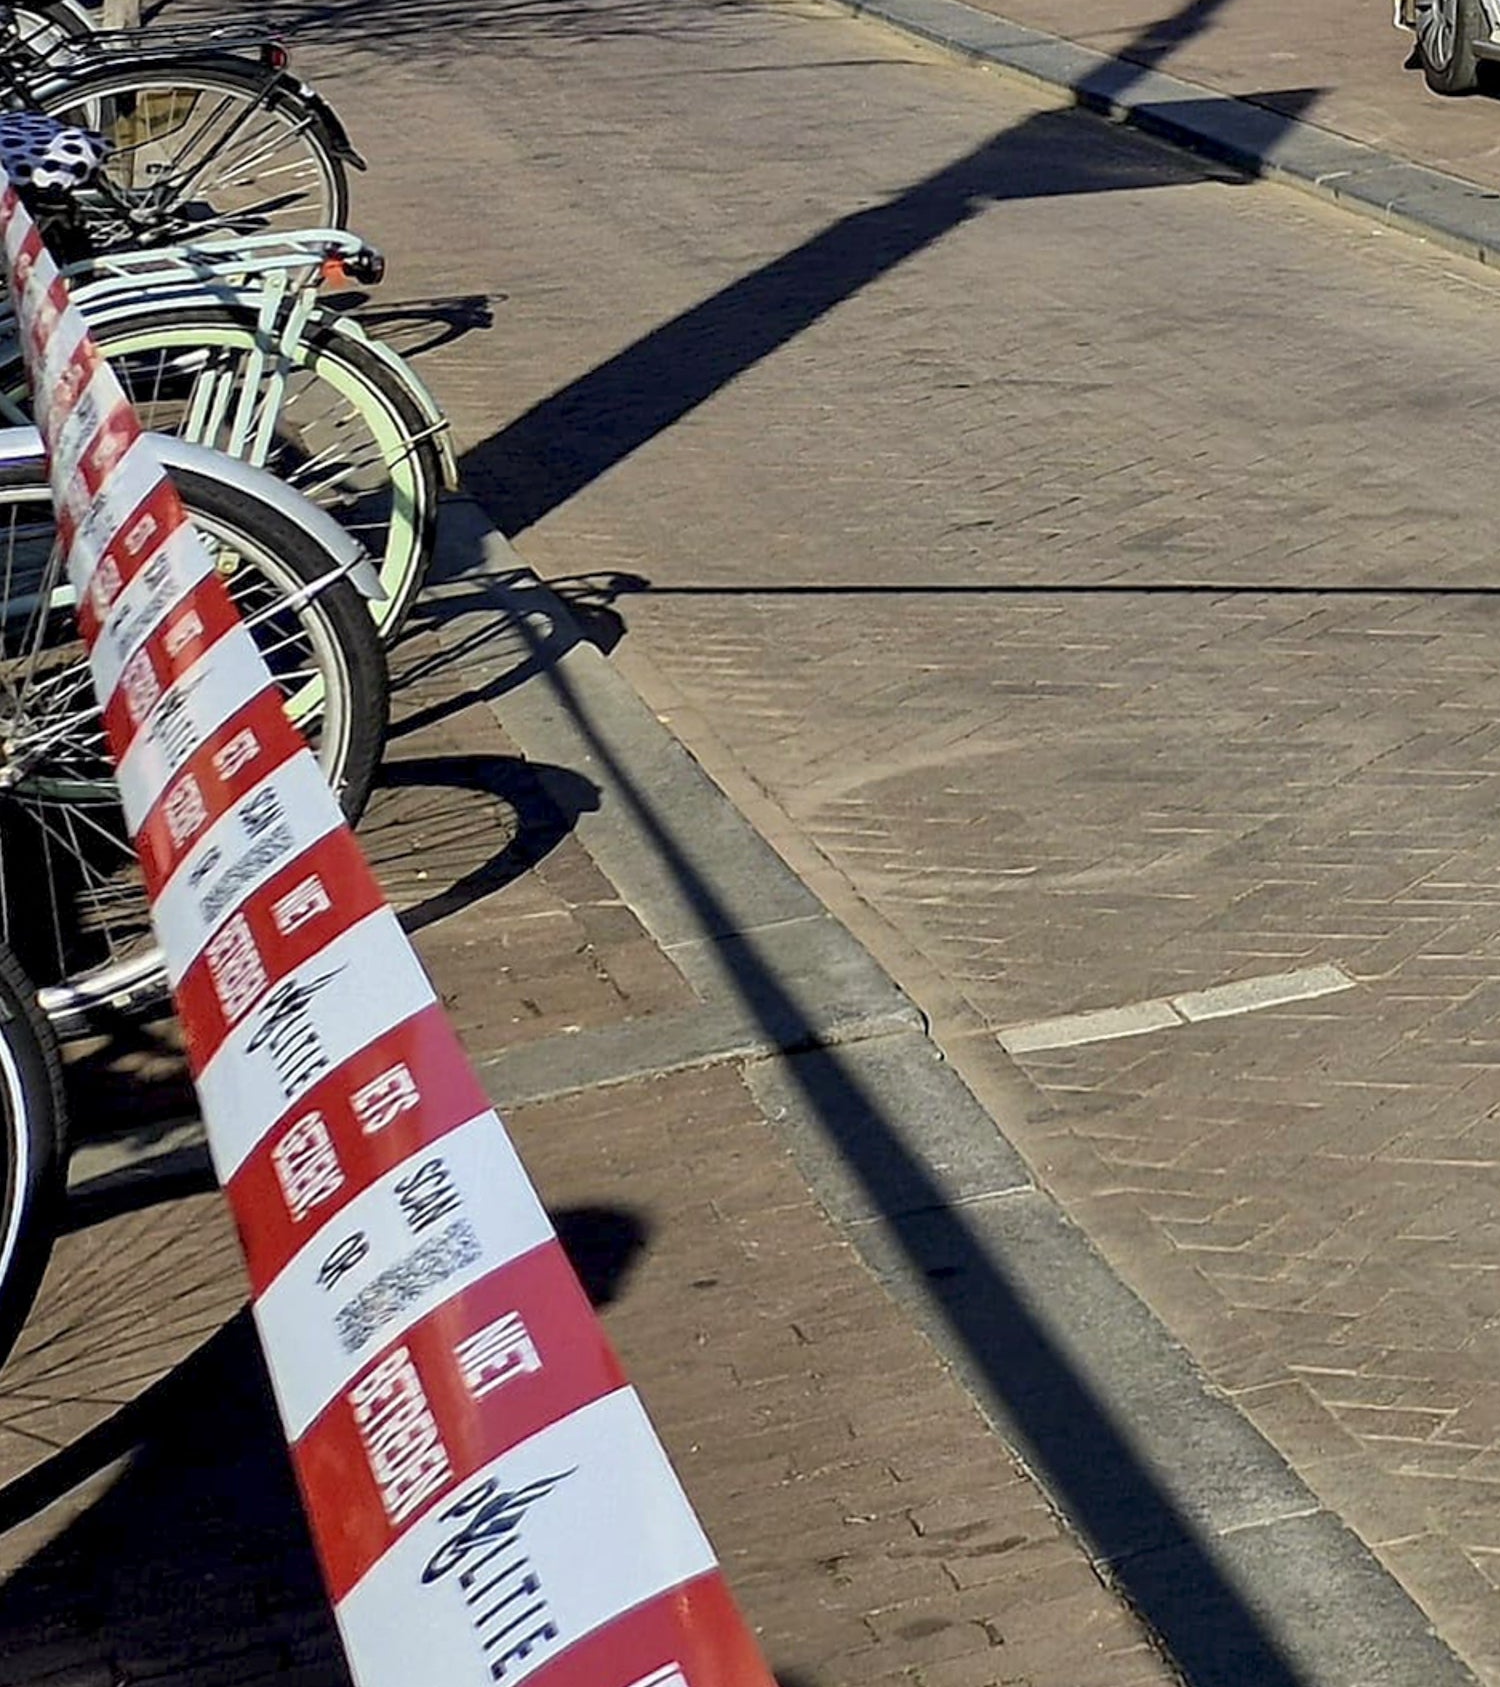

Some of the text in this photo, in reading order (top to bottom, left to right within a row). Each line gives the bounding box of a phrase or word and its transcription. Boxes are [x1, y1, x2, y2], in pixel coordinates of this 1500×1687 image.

[246, 978, 331, 1099] POLITIE
[394, 1157, 465, 1235] SCAN
[452, 1309, 544, 1404] NIET
[347, 1345, 454, 1529] BETREDEN
[421, 1475, 561, 1683] POLITIE
